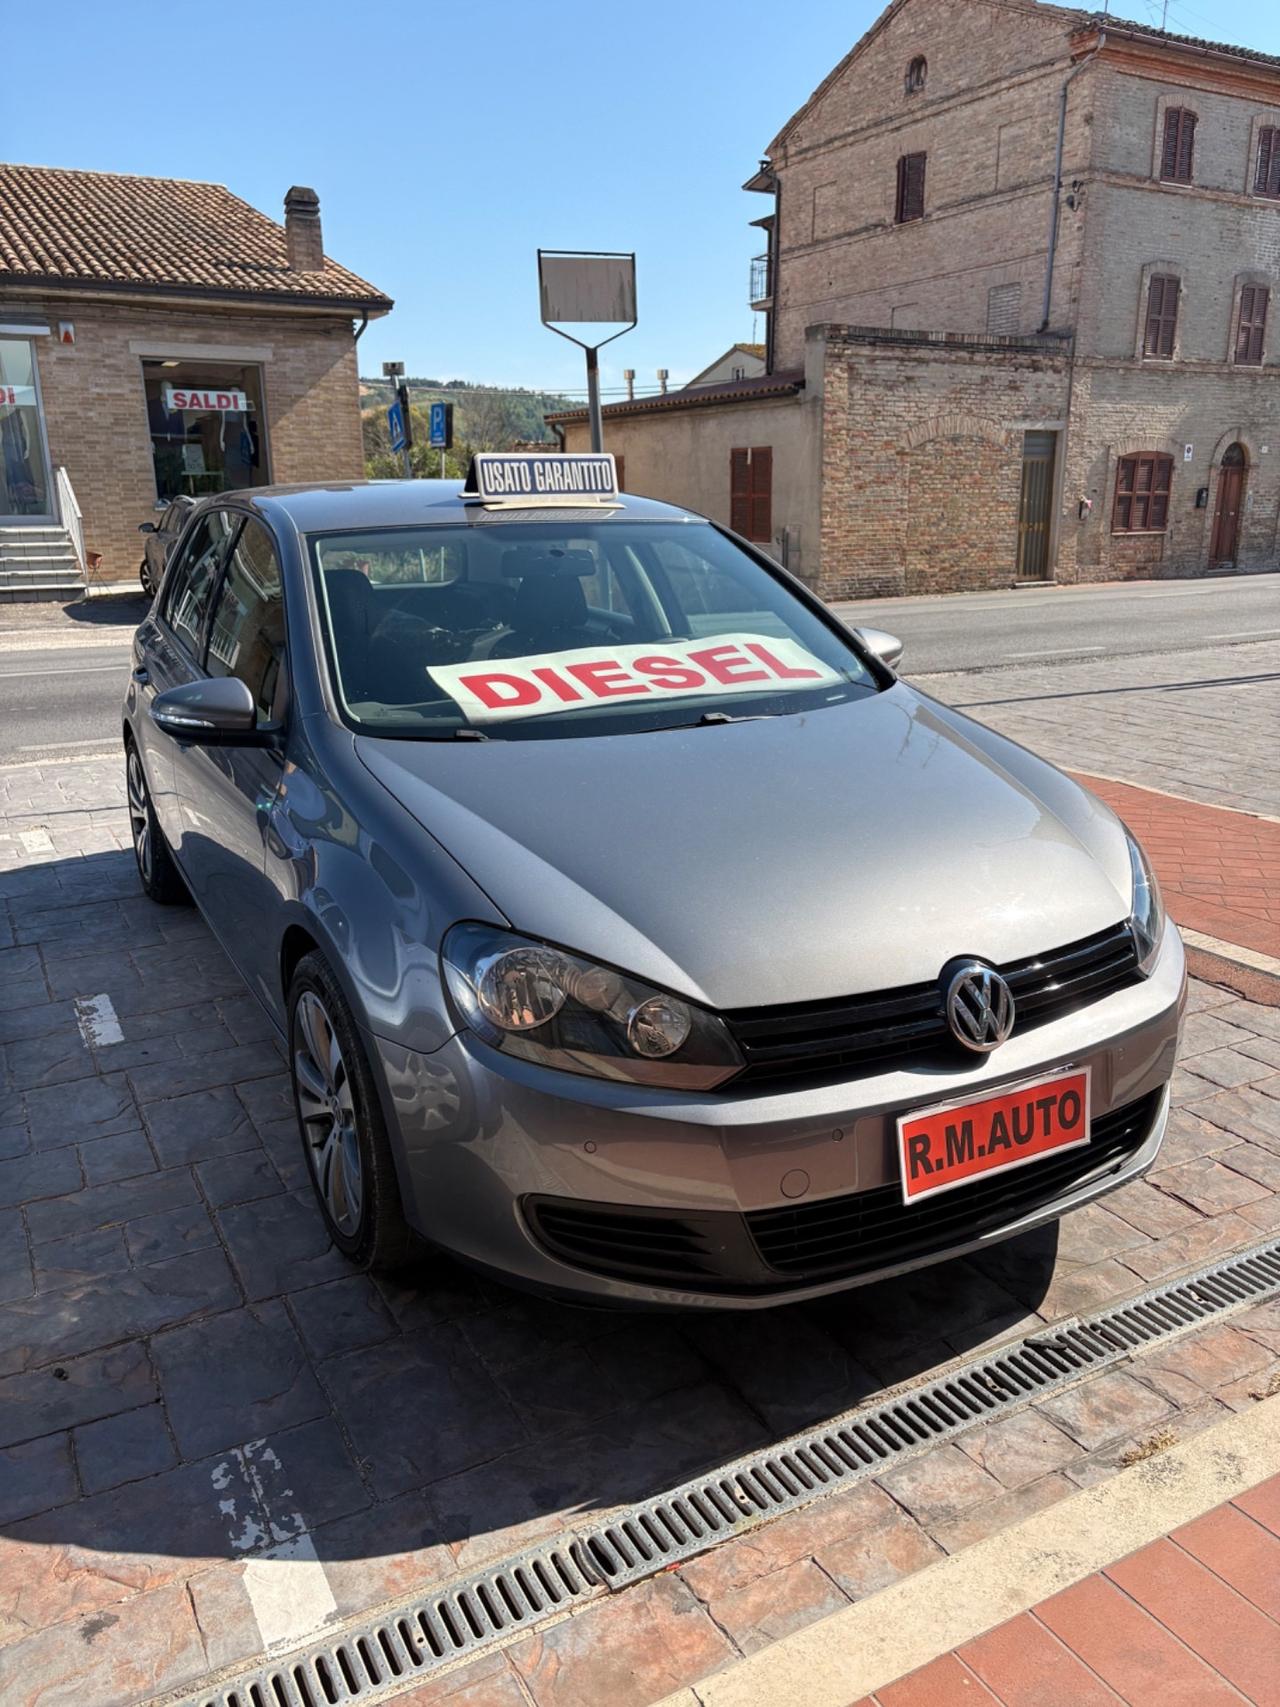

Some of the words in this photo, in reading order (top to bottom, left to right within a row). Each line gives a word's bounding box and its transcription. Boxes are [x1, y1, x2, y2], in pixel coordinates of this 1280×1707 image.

[173, 392, 239, 409] SALDI
[433, 406, 442, 431] P
[483, 461, 531, 493] USATO
[533, 461, 612, 492] GARANTITO
[459, 642, 823, 709] DIESEL
[908, 1090, 1081, 1179] R.M.AUTO
